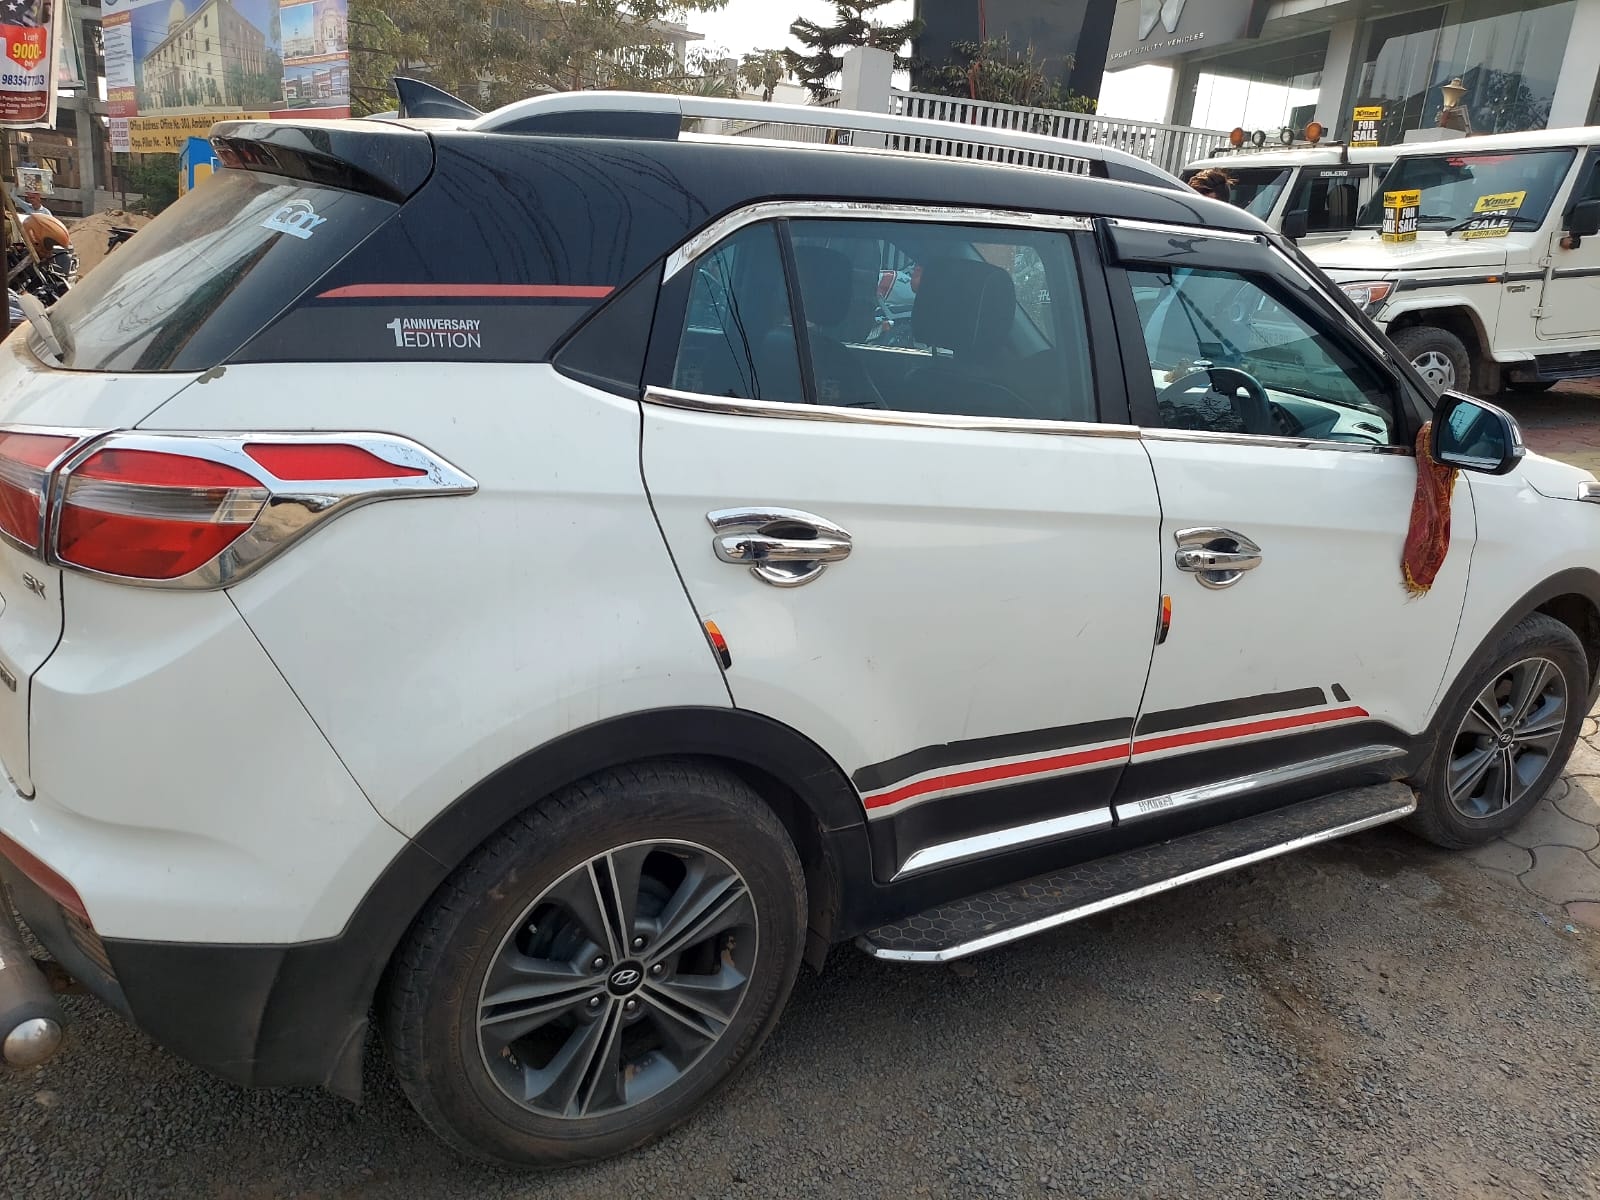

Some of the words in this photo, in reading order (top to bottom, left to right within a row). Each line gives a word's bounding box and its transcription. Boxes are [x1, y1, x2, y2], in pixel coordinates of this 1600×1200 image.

[1110, 49, 1132, 60] SPORT
[1135, 43, 1163, 54] UTILITY
[1167, 32, 1205, 46] VEHICLES
[1357, 120, 1375, 130] FOR
[1352, 130, 1378, 140] SALE
[1481, 196, 1518, 207] Xmart
[1402, 207, 1416, 219] FOR
[1382, 219, 1396, 233] SALE
[1398, 218, 1418, 233] SALE
[1468, 219, 1510, 230] SALE
[386, 318, 404, 347] 1
[403, 318, 481, 330] ANNIVERSARY
[404, 331, 481, 348] EDITION
